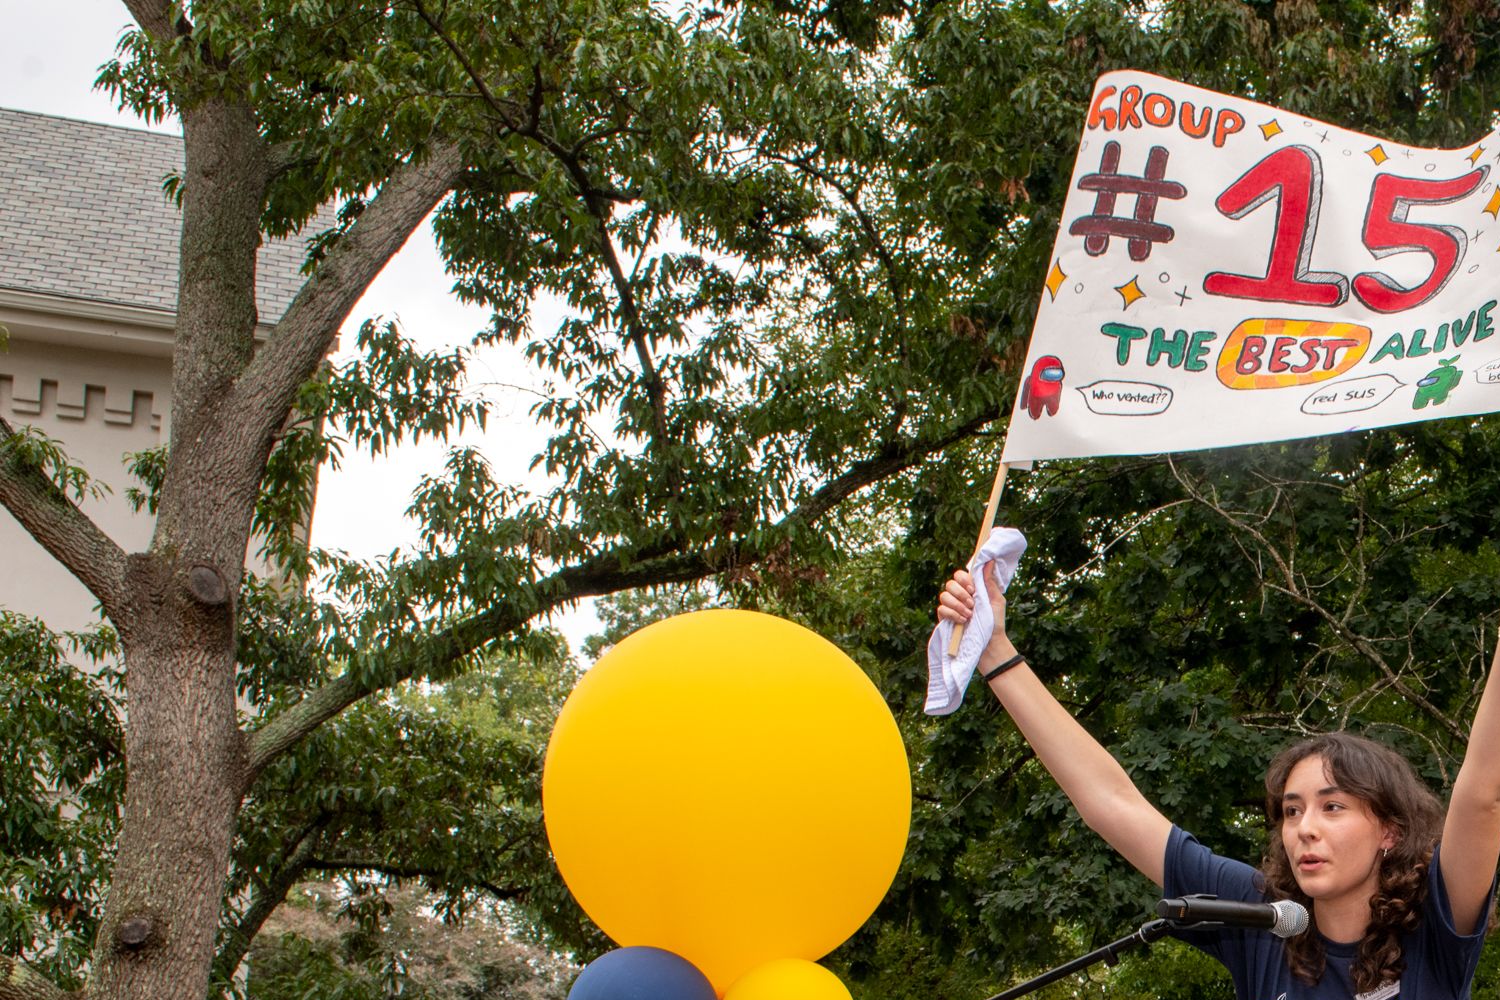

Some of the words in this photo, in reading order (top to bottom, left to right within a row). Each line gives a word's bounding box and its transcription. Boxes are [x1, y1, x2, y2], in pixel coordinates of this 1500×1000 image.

[1088, 85, 1245, 148] GROUP
[1101, 322, 1216, 372] THE
[1236, 336, 1361, 376] BEST
[1312, 392, 1338, 405] red
